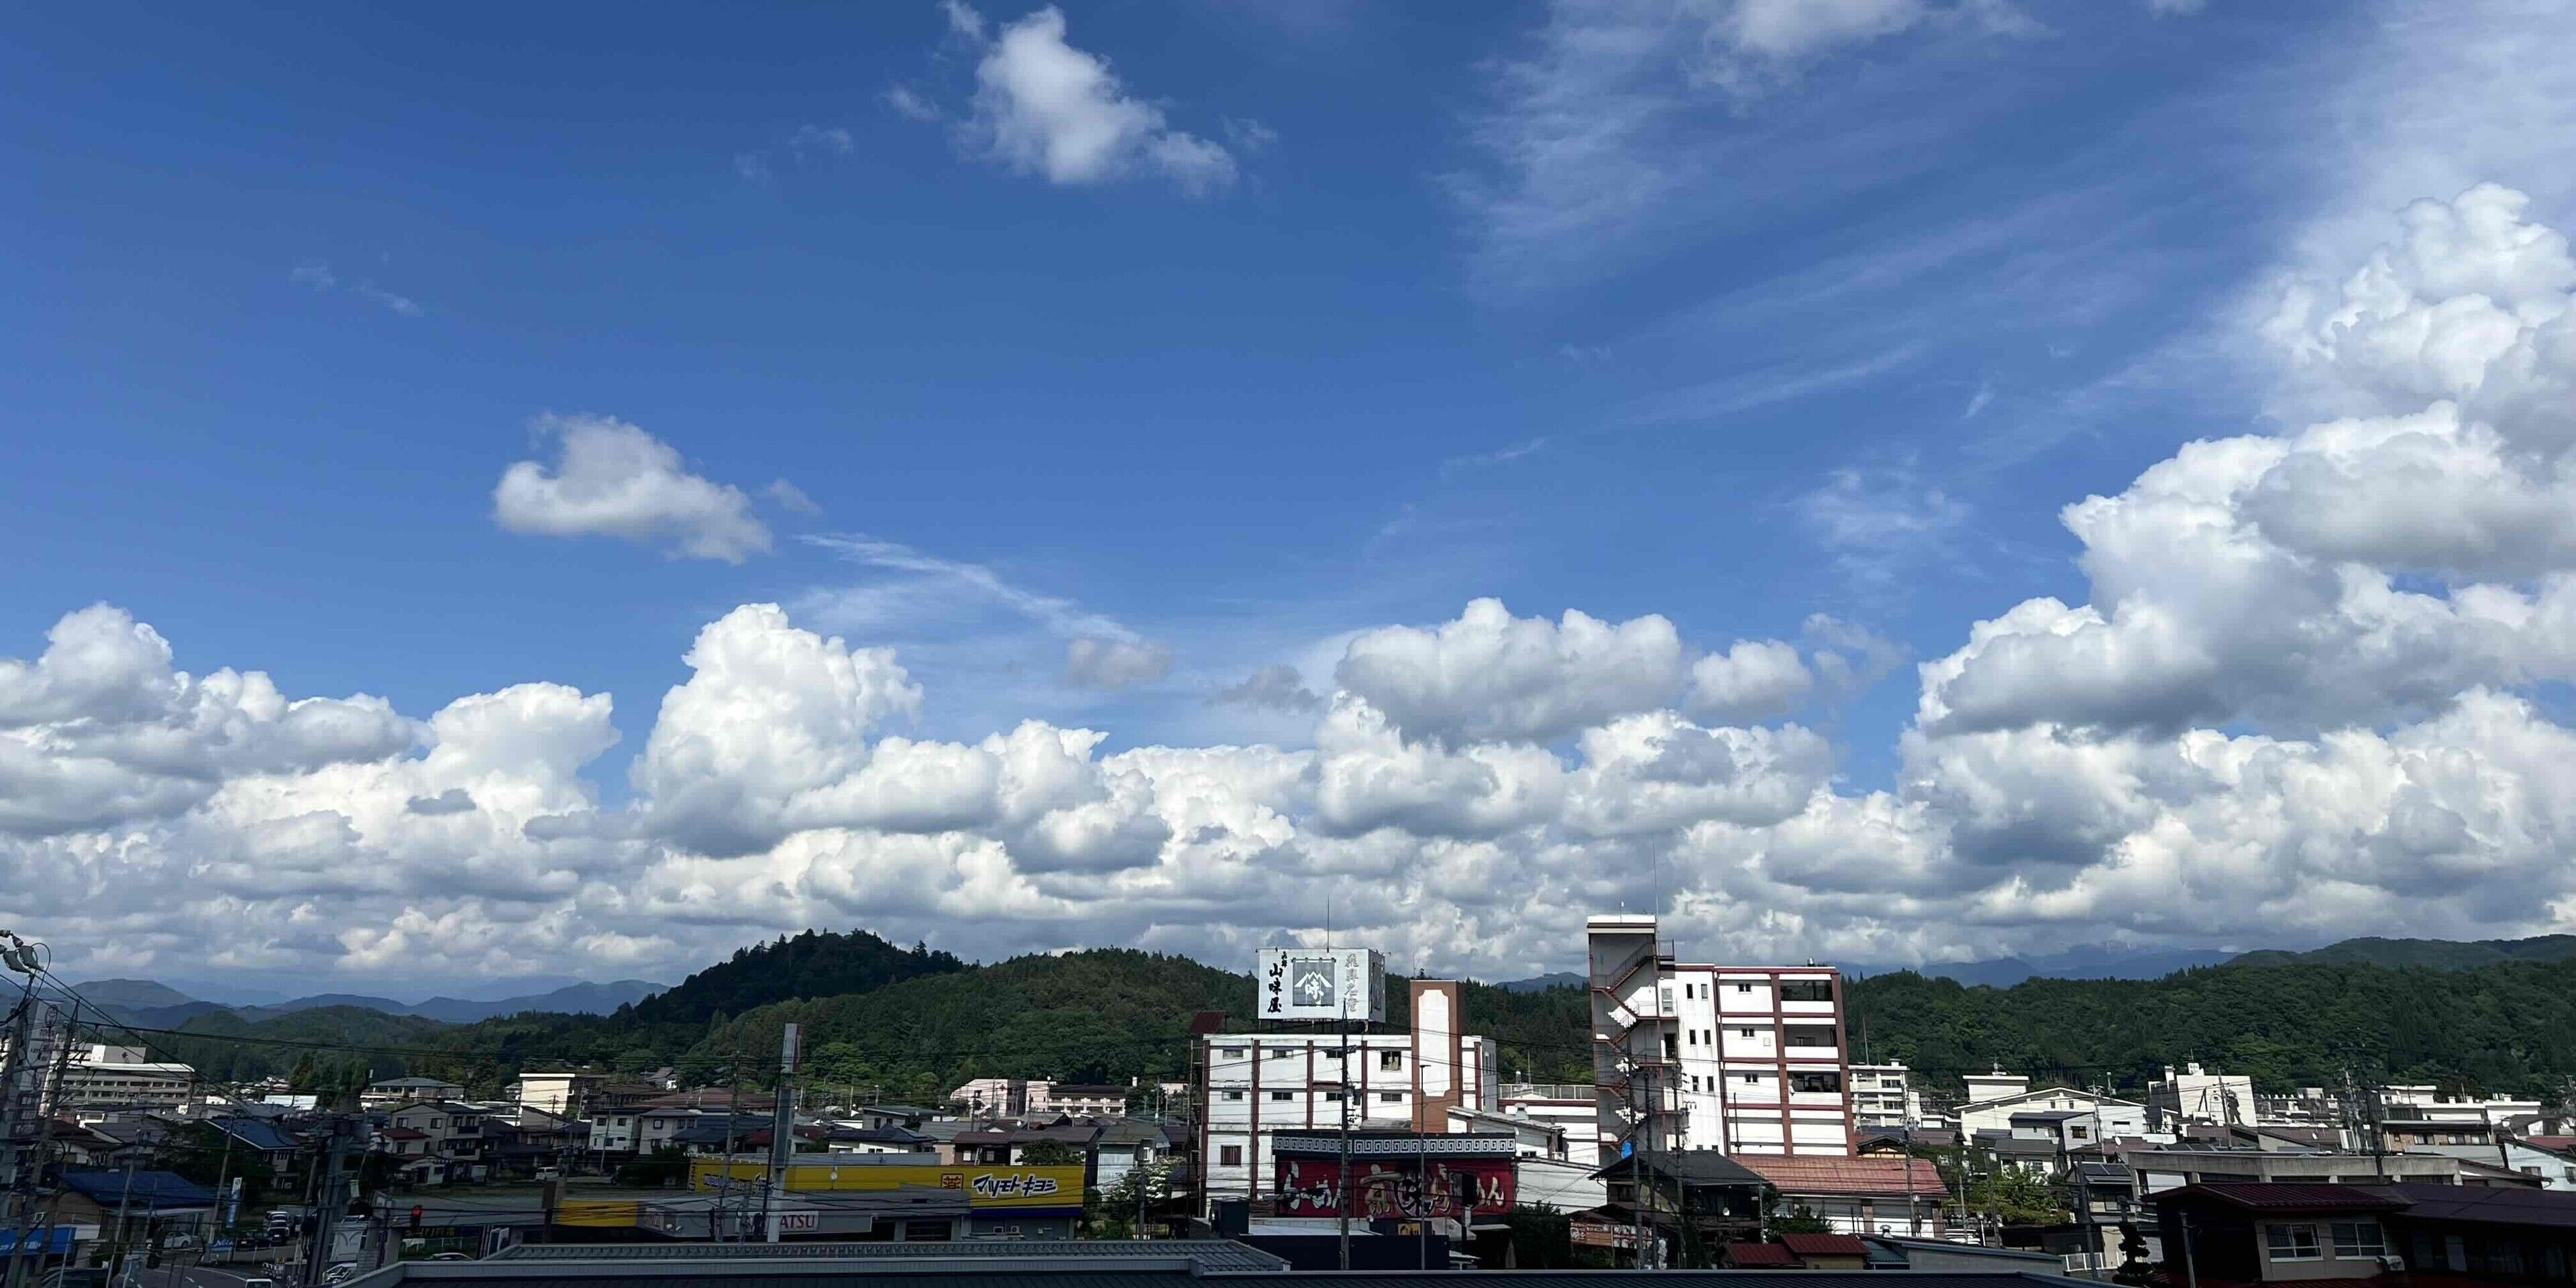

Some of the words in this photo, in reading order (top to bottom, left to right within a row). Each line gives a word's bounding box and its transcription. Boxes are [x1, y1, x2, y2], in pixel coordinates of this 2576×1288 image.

[973, 1174, 1058, 1197] マツモトキヨシ
